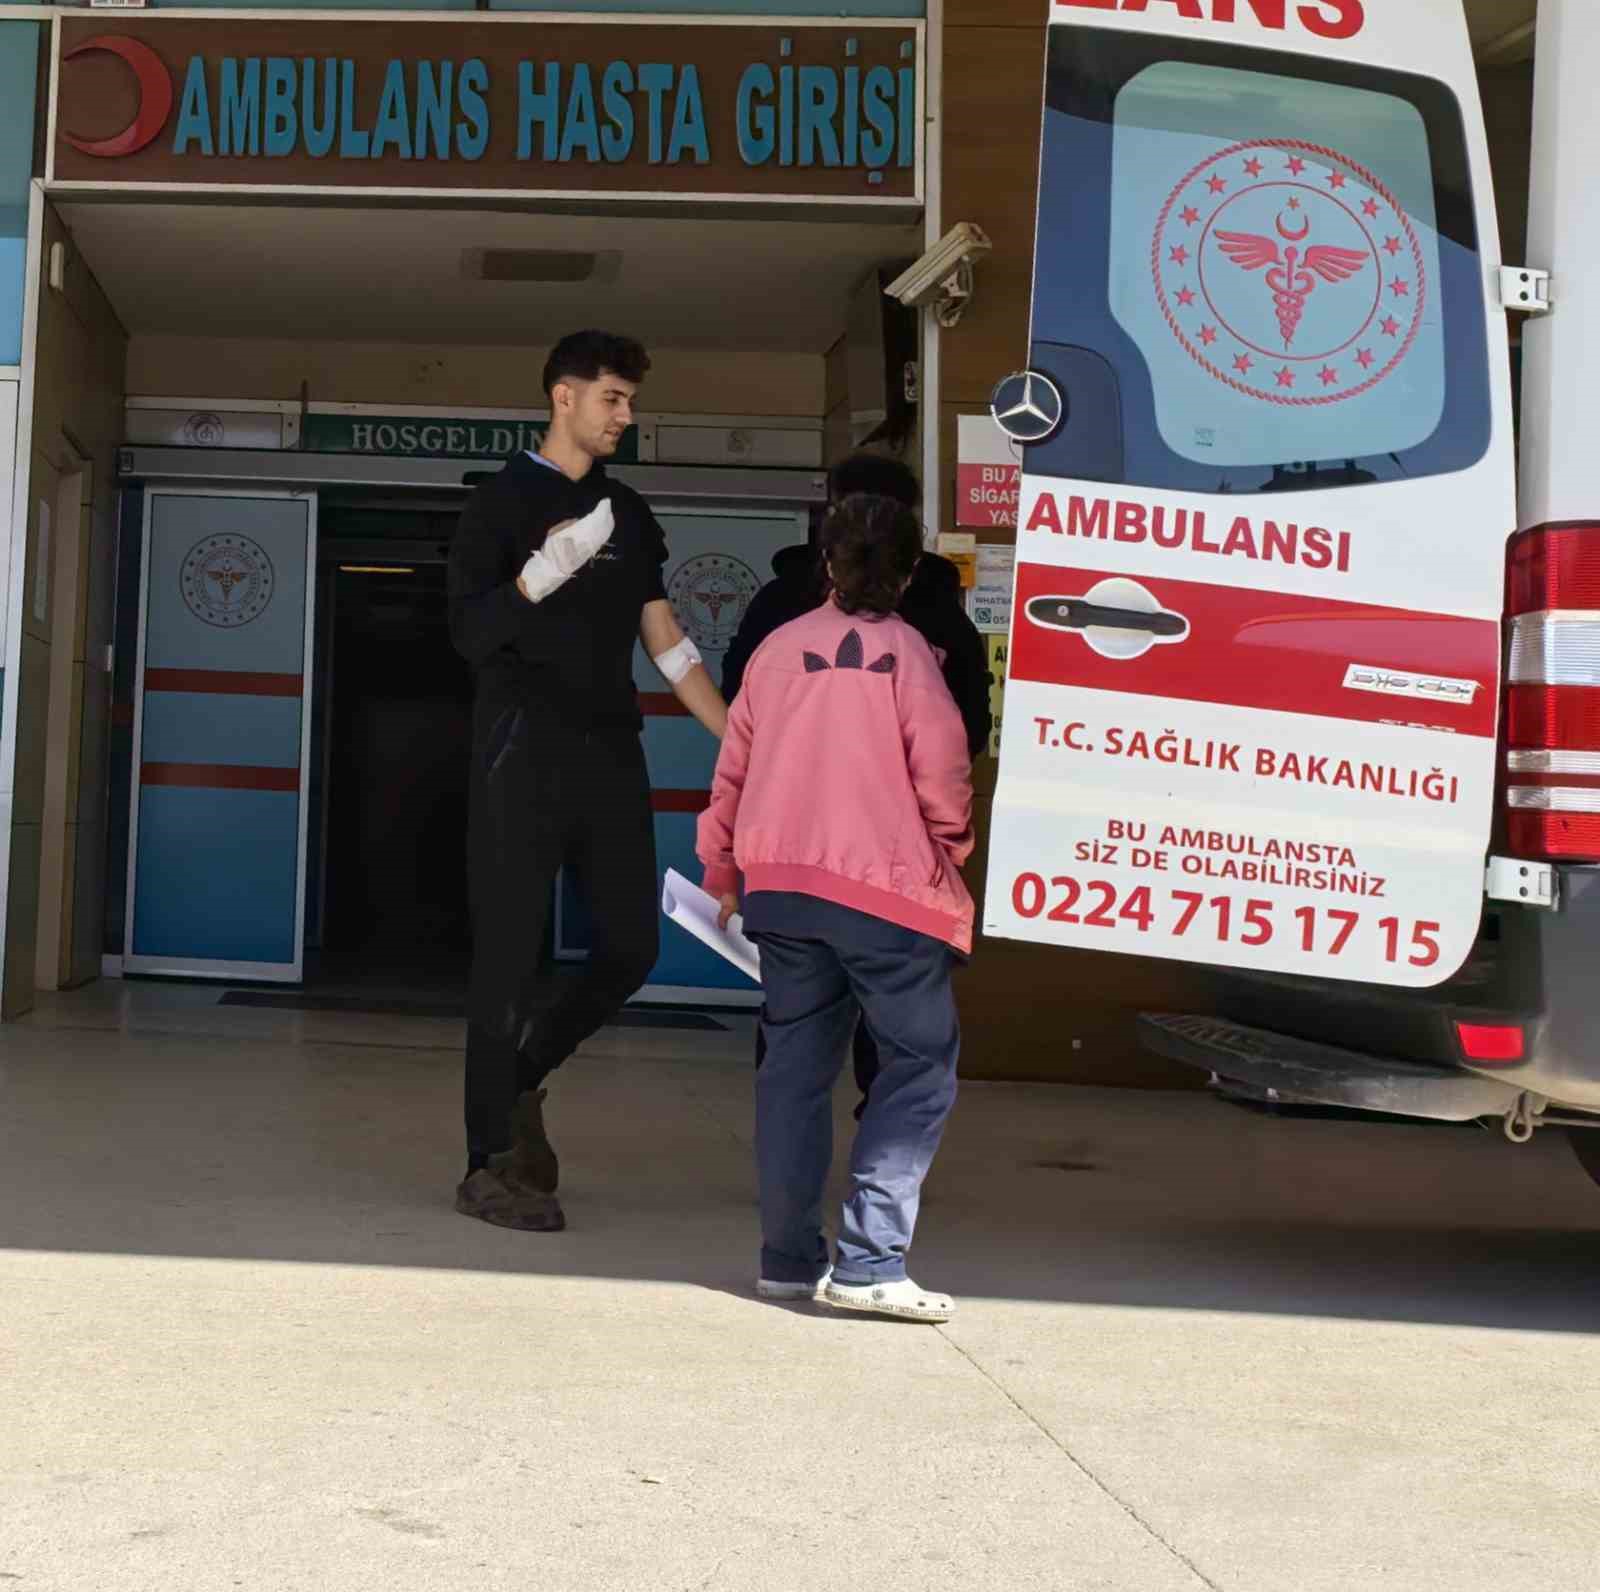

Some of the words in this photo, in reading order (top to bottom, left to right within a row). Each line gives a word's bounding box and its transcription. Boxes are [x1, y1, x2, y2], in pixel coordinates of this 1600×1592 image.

[172, 56, 489, 160] AMBULANS
[517, 60, 709, 164] HASTA
[736, 37, 913, 184] GİRİŞİ
[983, 467, 1006, 482] BU
[1025, 492, 1351, 572] AMBULANSI
[1033, 717, 1093, 752] T.C.
[1103, 727, 1241, 772] SAĞLIK
[1255, 748, 1458, 803] BAKANLIĞI
[1074, 840, 1118, 865] SİZ
[1131, 848, 1168, 870] DE
[1181, 855, 1386, 897] OLABİLİRSİNİZ
[1107, 819, 1147, 842] BU
[1159, 826, 1356, 867] AMBULANSTA
[1011, 872, 1155, 932] 0224
[1171, 890, 1274, 945] 715
[1294, 905, 1360, 956] 17
[1378, 916, 1441, 967] 15
